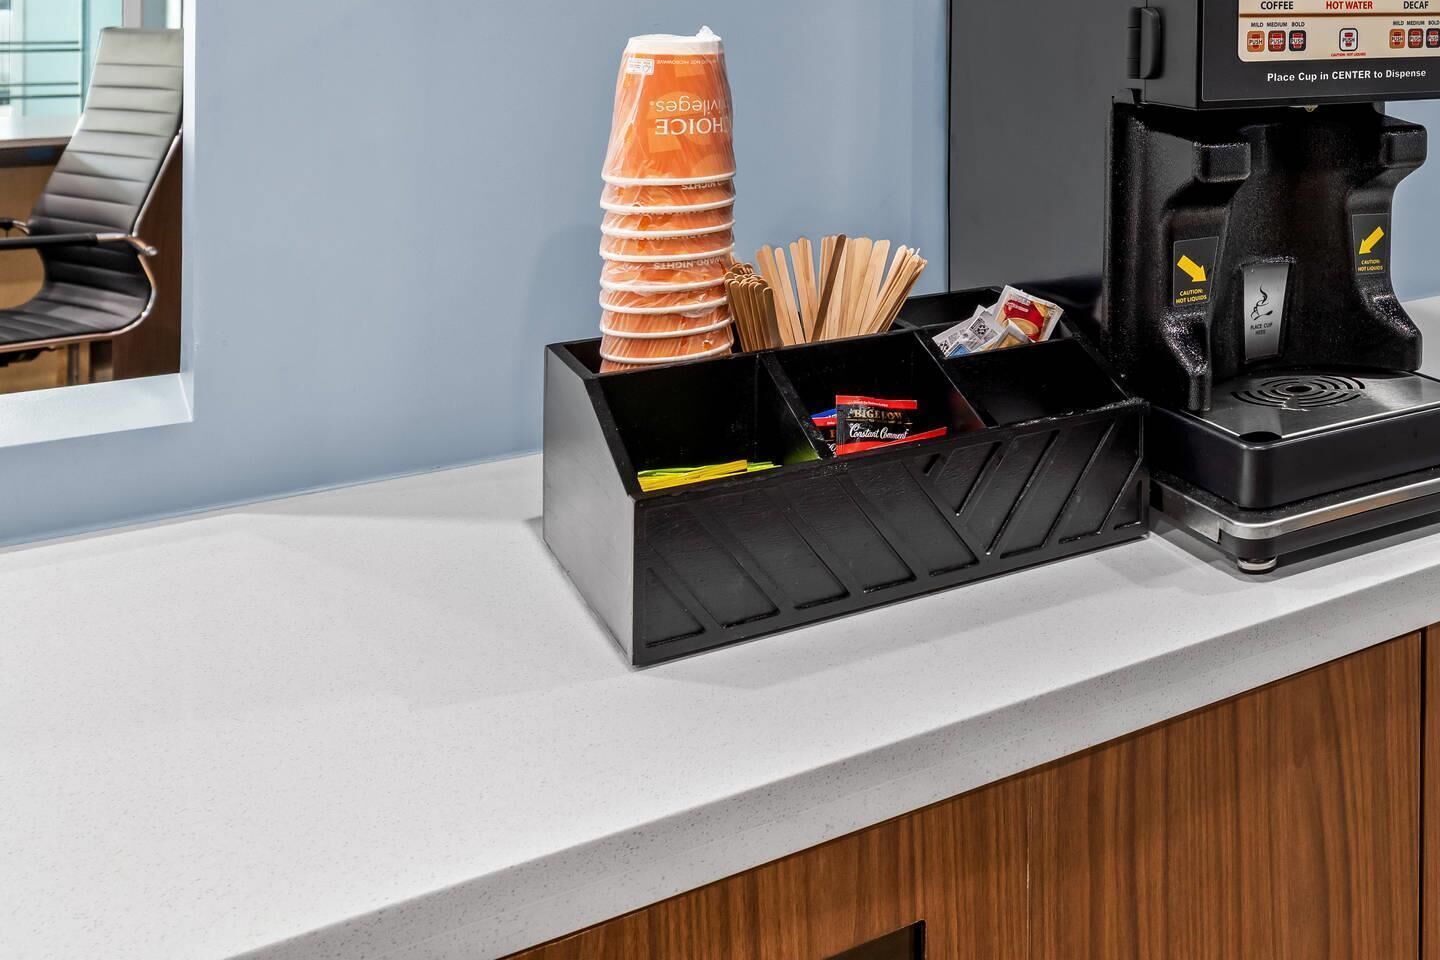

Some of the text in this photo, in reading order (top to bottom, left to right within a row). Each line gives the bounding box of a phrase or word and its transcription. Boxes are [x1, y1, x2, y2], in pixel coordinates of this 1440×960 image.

[1260, 0, 1429, 10] COFFEE HOT WATER DECAF
[1267, 69, 1427, 83] Place Cup in CENTER to Dispense
[654, 260, 695, 270] NIGHTS
[1187, 295, 1207, 303] LIQUIDS
[855, 408, 905, 420] BIGELOW
